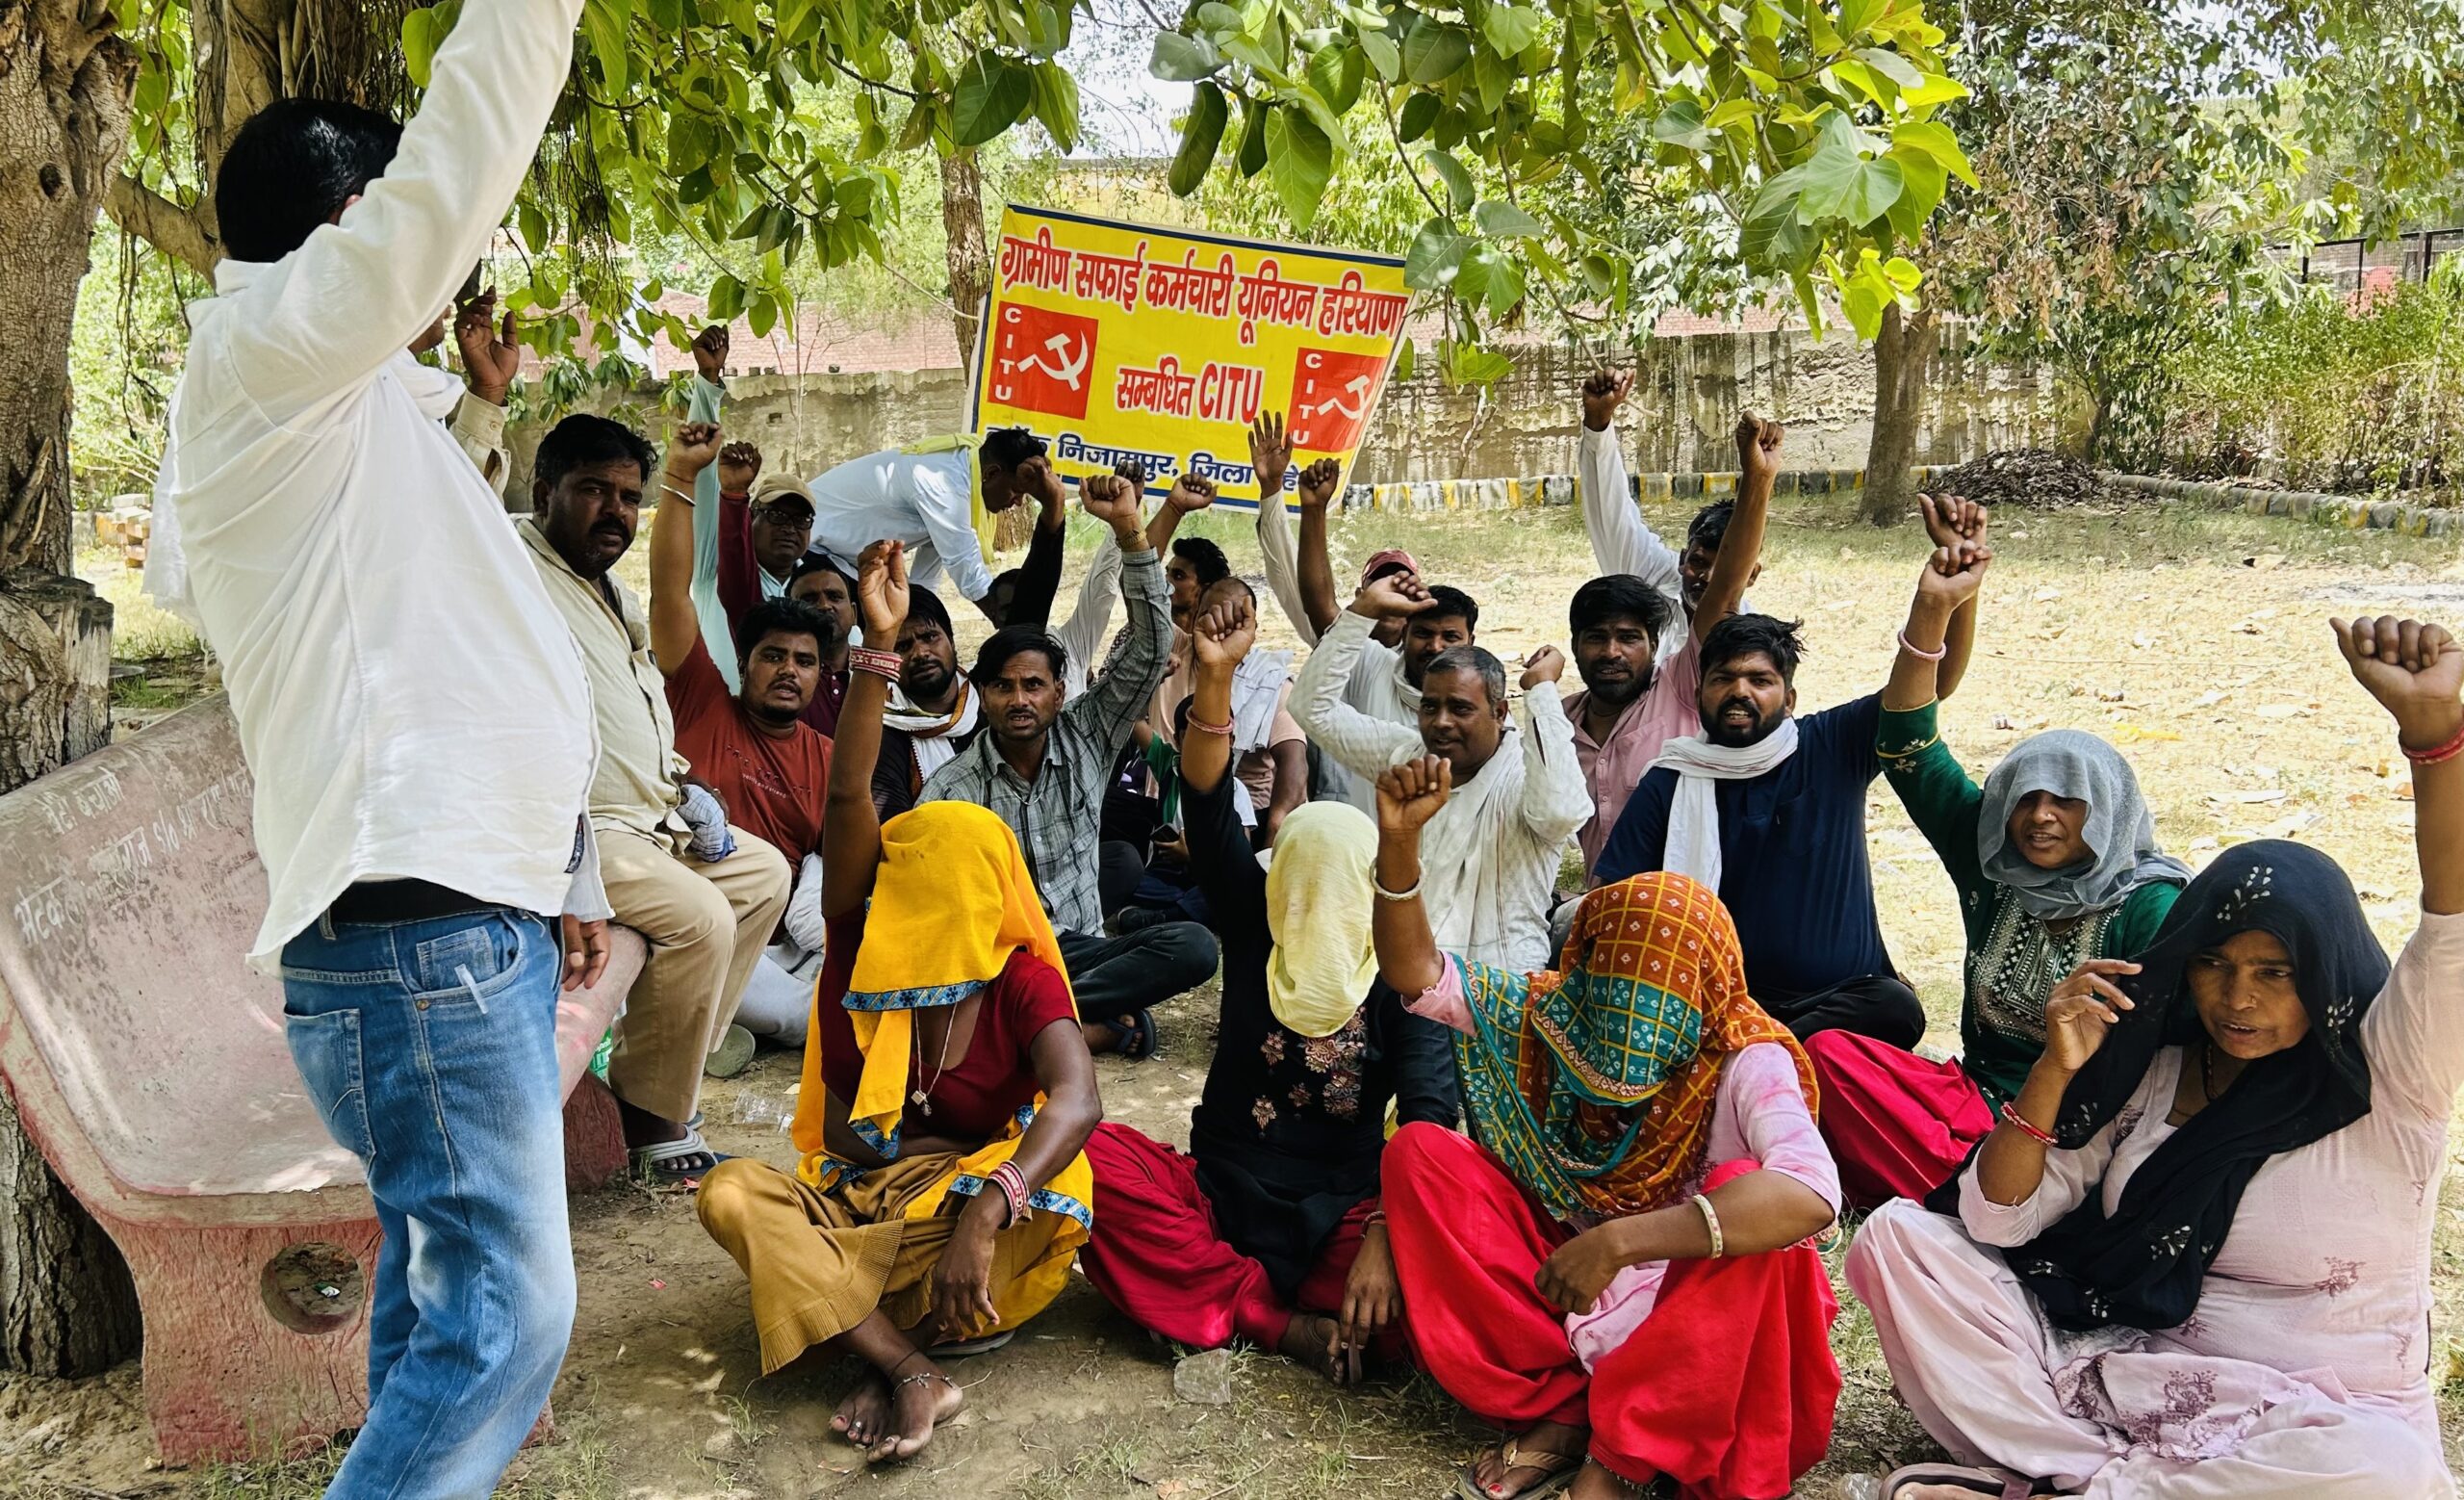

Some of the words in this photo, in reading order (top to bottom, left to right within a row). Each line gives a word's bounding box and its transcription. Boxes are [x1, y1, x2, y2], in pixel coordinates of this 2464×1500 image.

[1001, 226, 1071, 292] ग्रामीण
[1075, 242, 1146, 312] सफाई
[1146, 248, 1234, 316] कर्मचारी
[1238, 259, 1319, 344] यूनियन
[994, 307, 1022, 401] CITU
[1199, 363, 1263, 424] CITU
[1292, 353, 1322, 445] CITU
